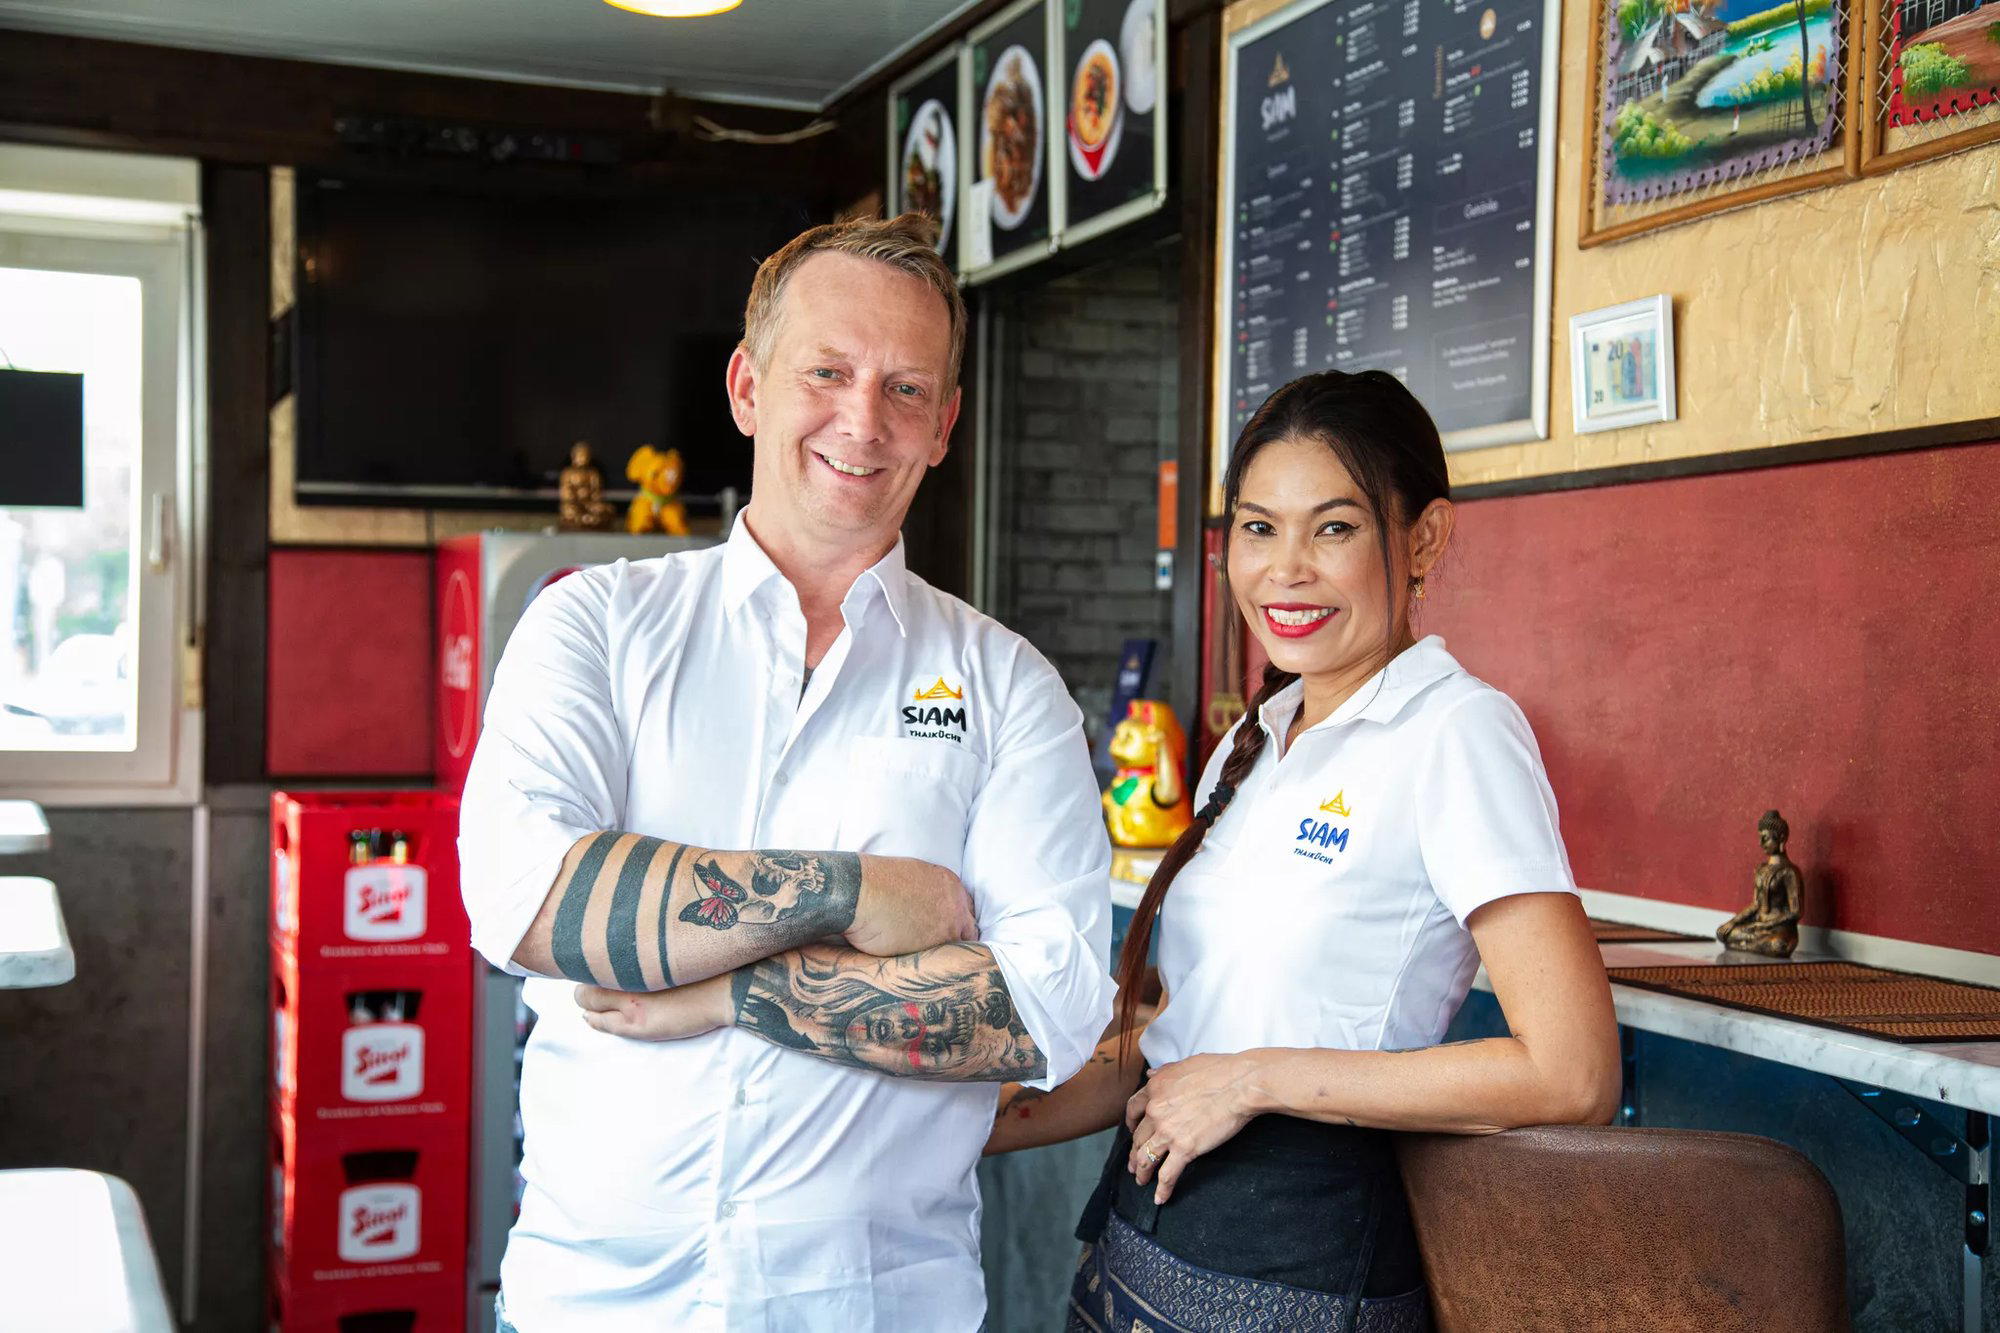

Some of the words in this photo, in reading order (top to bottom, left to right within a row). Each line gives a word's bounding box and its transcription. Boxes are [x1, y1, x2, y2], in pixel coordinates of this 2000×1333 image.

[902, 706, 967, 732] SIAM
[910, 729, 962, 743] THAIKÜCHE
[1296, 817, 1350, 853] SIAM
[1294, 847, 1333, 865] THAIKÜCHE
